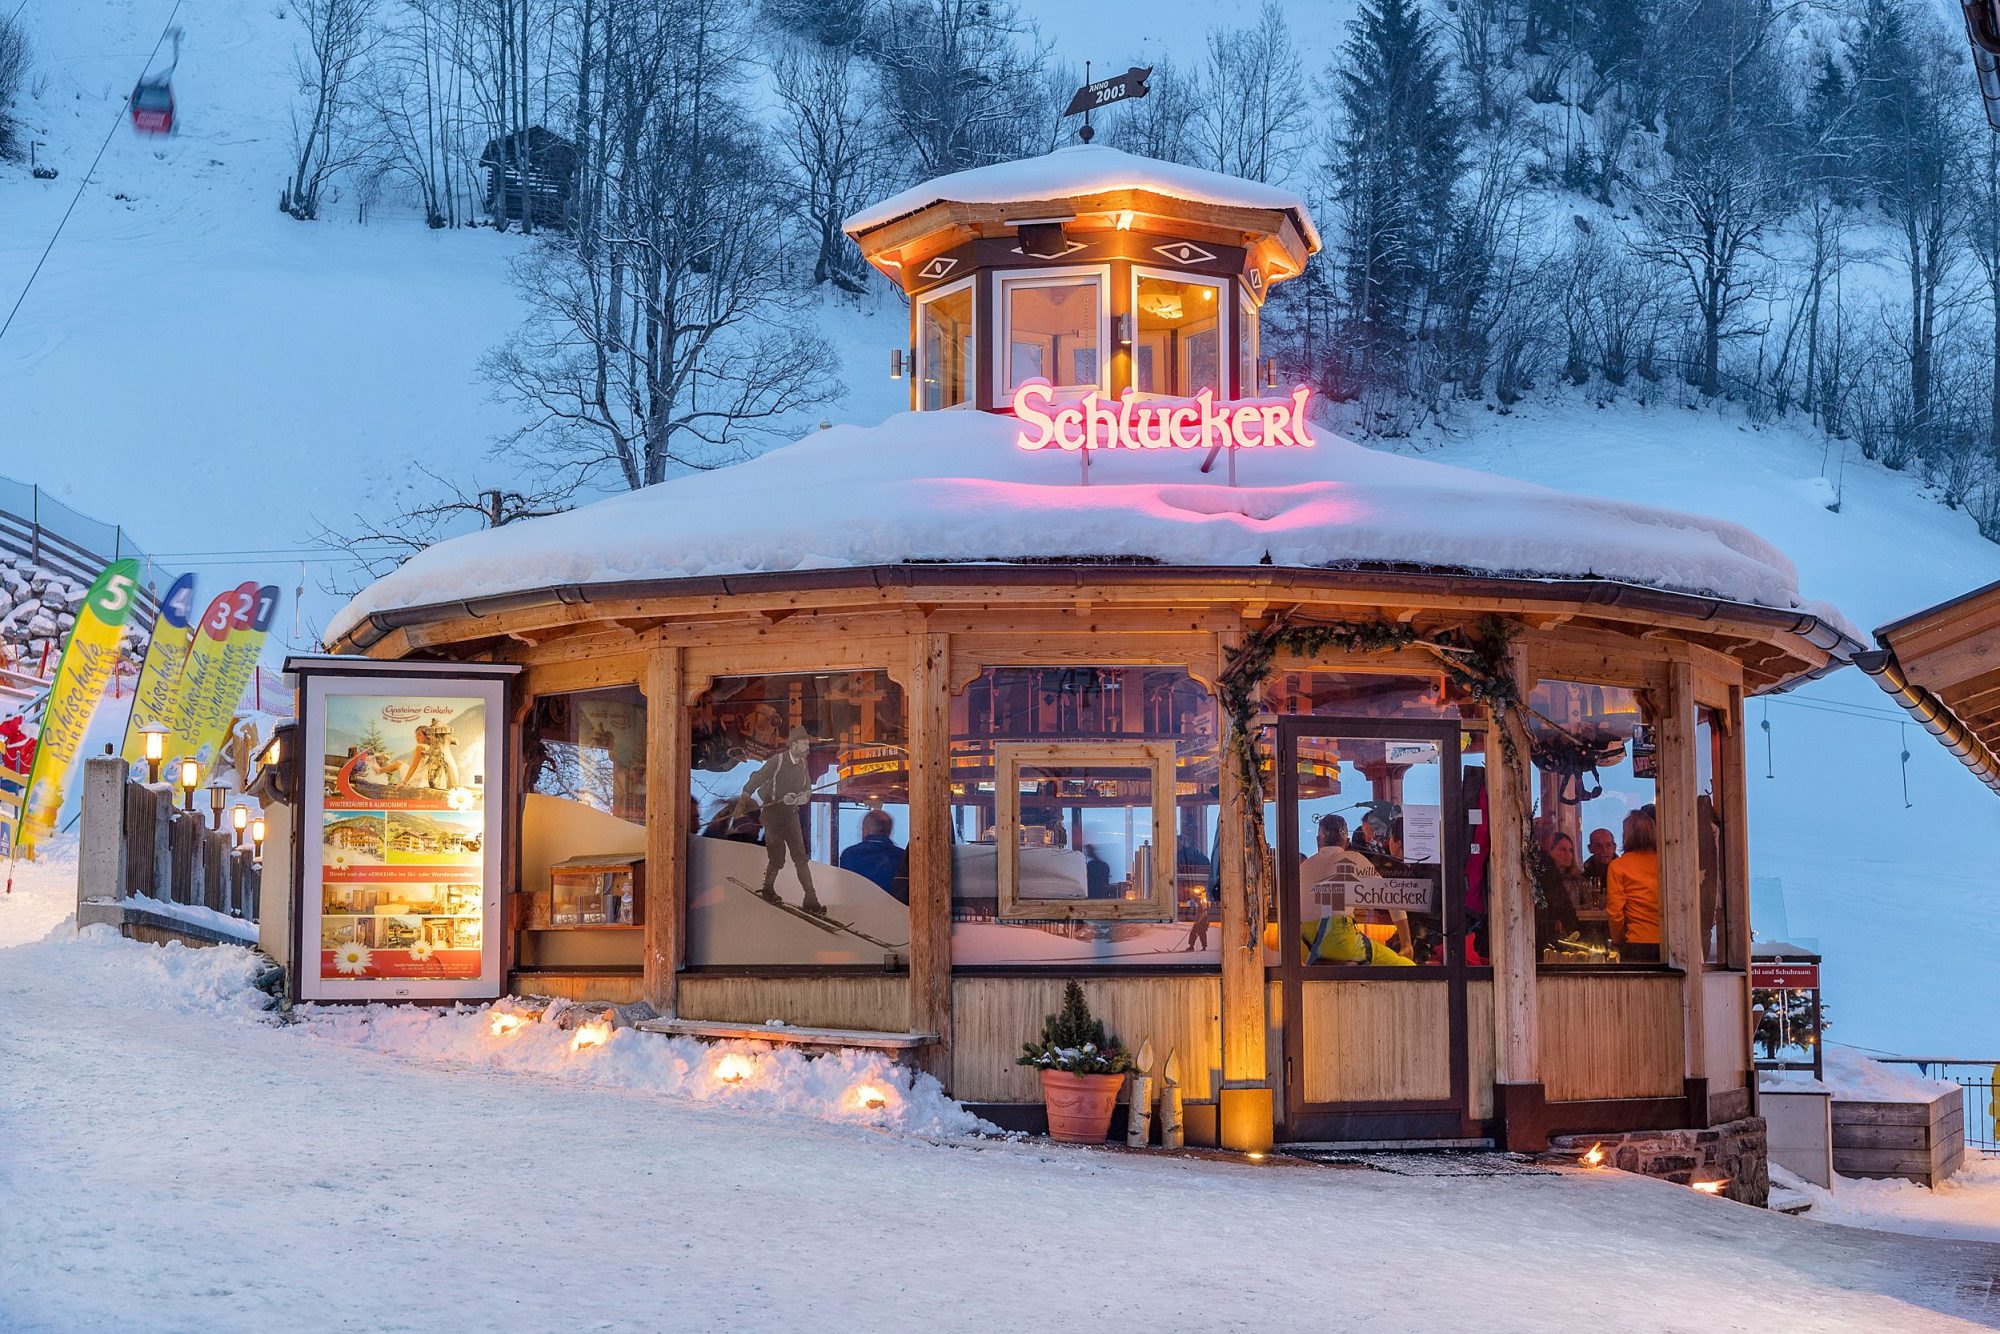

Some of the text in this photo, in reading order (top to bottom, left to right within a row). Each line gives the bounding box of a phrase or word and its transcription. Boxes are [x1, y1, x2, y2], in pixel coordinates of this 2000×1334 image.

[1089, 81, 1109, 93] ANNO
[1096, 84, 1125, 104] 2003
[1014, 384, 1316, 450] Schluckerl
[100, 574, 133, 611] 5
[168, 586, 192, 618] 4
[211, 602, 231, 630] 3
[233, 593, 254, 622] 2
[256, 597, 272, 622] 1
[43, 638, 104, 758] Schischule
[423, 705, 453, 715] Einkehr
[1353, 884, 1429, 904] Schluckerl
[1389, 878, 1419, 889] Einkehr
